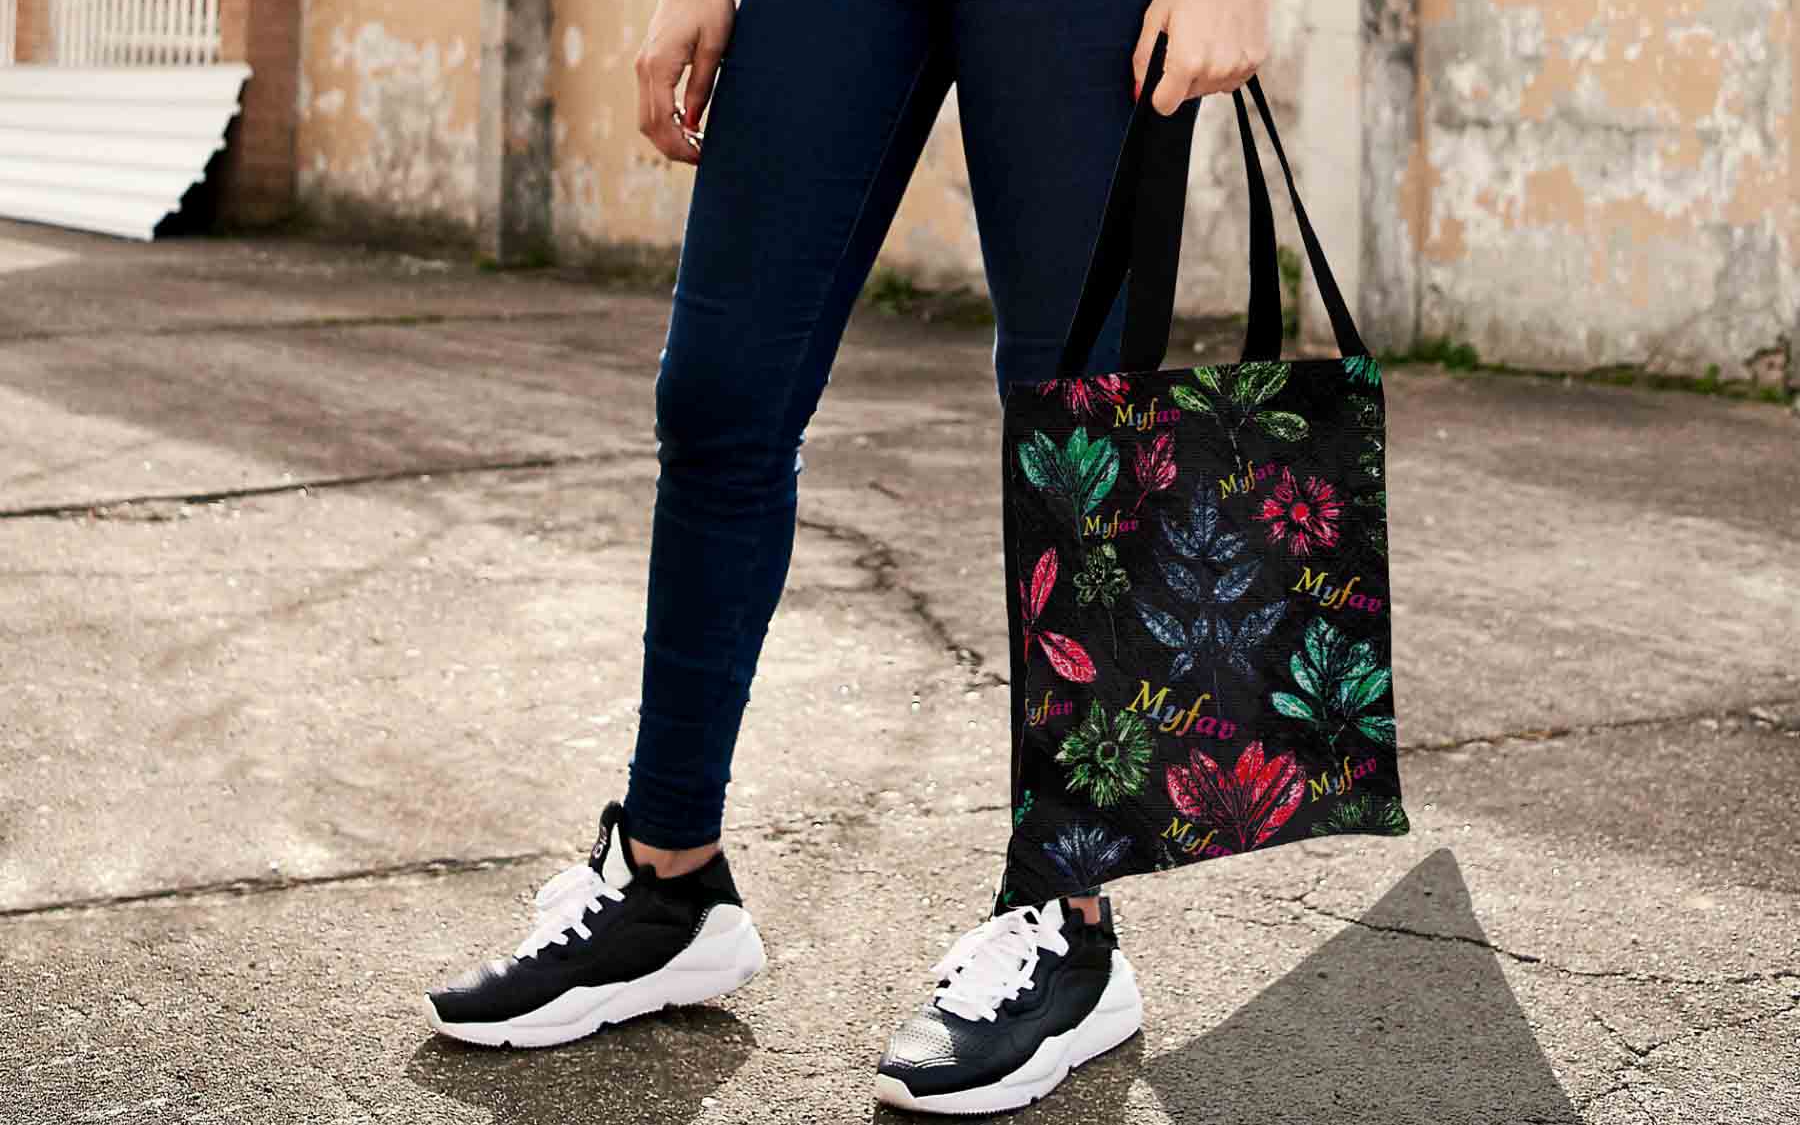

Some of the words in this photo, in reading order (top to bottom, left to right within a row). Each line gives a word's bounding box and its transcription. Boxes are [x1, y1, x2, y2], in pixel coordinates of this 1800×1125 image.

[1113, 398, 1182, 432] Myfav
[1219, 459, 1279, 500] Myfav
[1082, 510, 1138, 540] Myfav
[1292, 566, 1383, 614] Myfav
[1125, 679, 1239, 740] Myfav
[1307, 756, 1378, 802] Myfav
